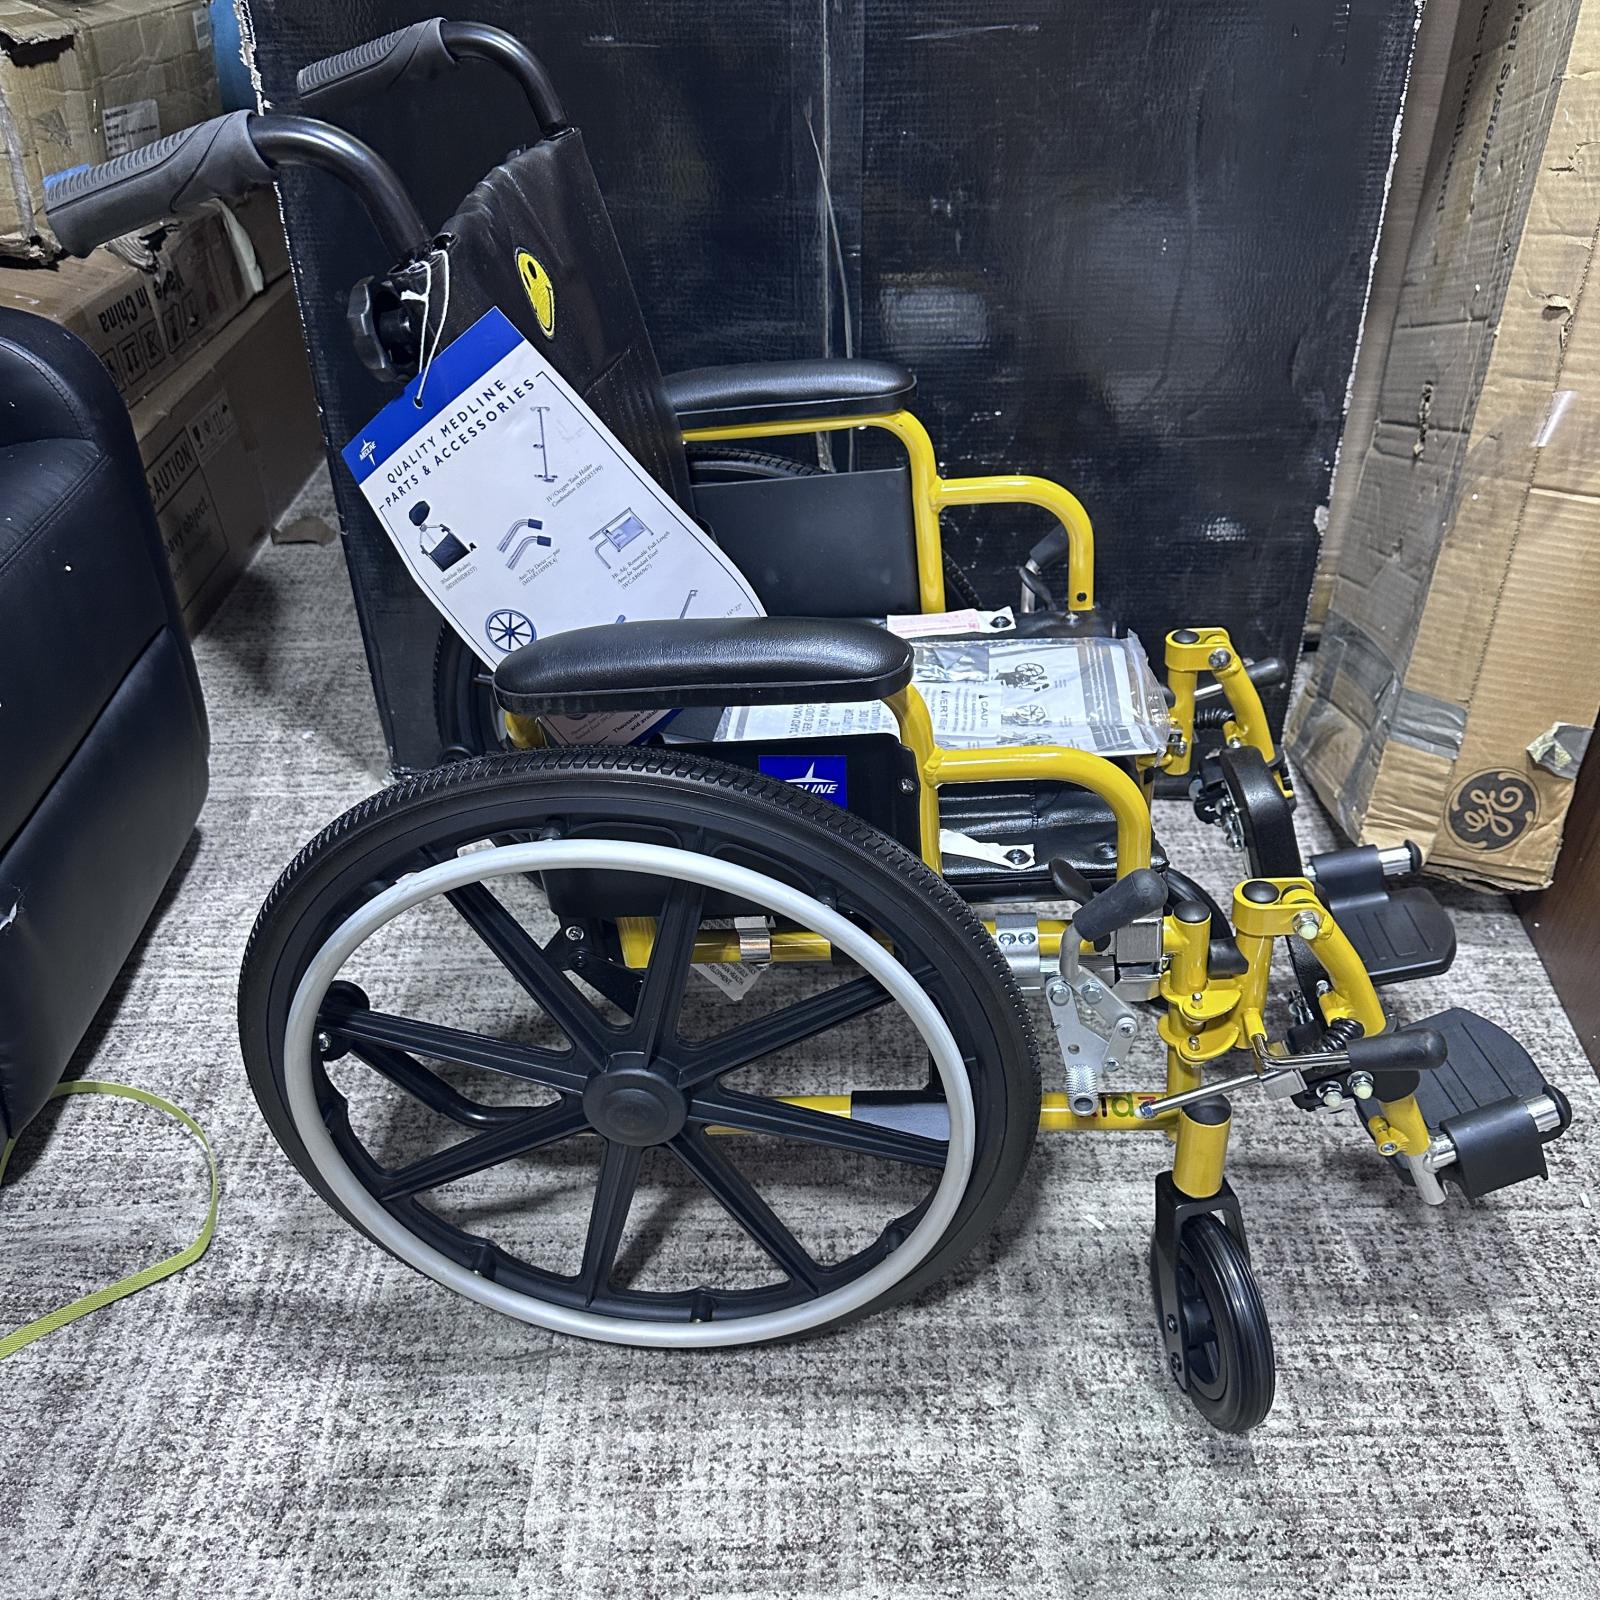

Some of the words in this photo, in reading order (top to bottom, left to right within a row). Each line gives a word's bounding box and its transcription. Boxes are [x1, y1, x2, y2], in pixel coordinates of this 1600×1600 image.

[1436, 53, 1482, 213] Panelboard
[1478, 62, 1512, 184] Systems
[97, 294, 139, 334] China
[149, 440, 193, 505] AUTION
[384, 474, 420, 508] PARTS
[422, 465, 431, 476] &
[434, 378, 535, 467] ACCESSORIES
[386, 436, 437, 484] QUALITY
[440, 379, 507, 438] MEDLINE
[1458, 780, 1530, 843] GE
